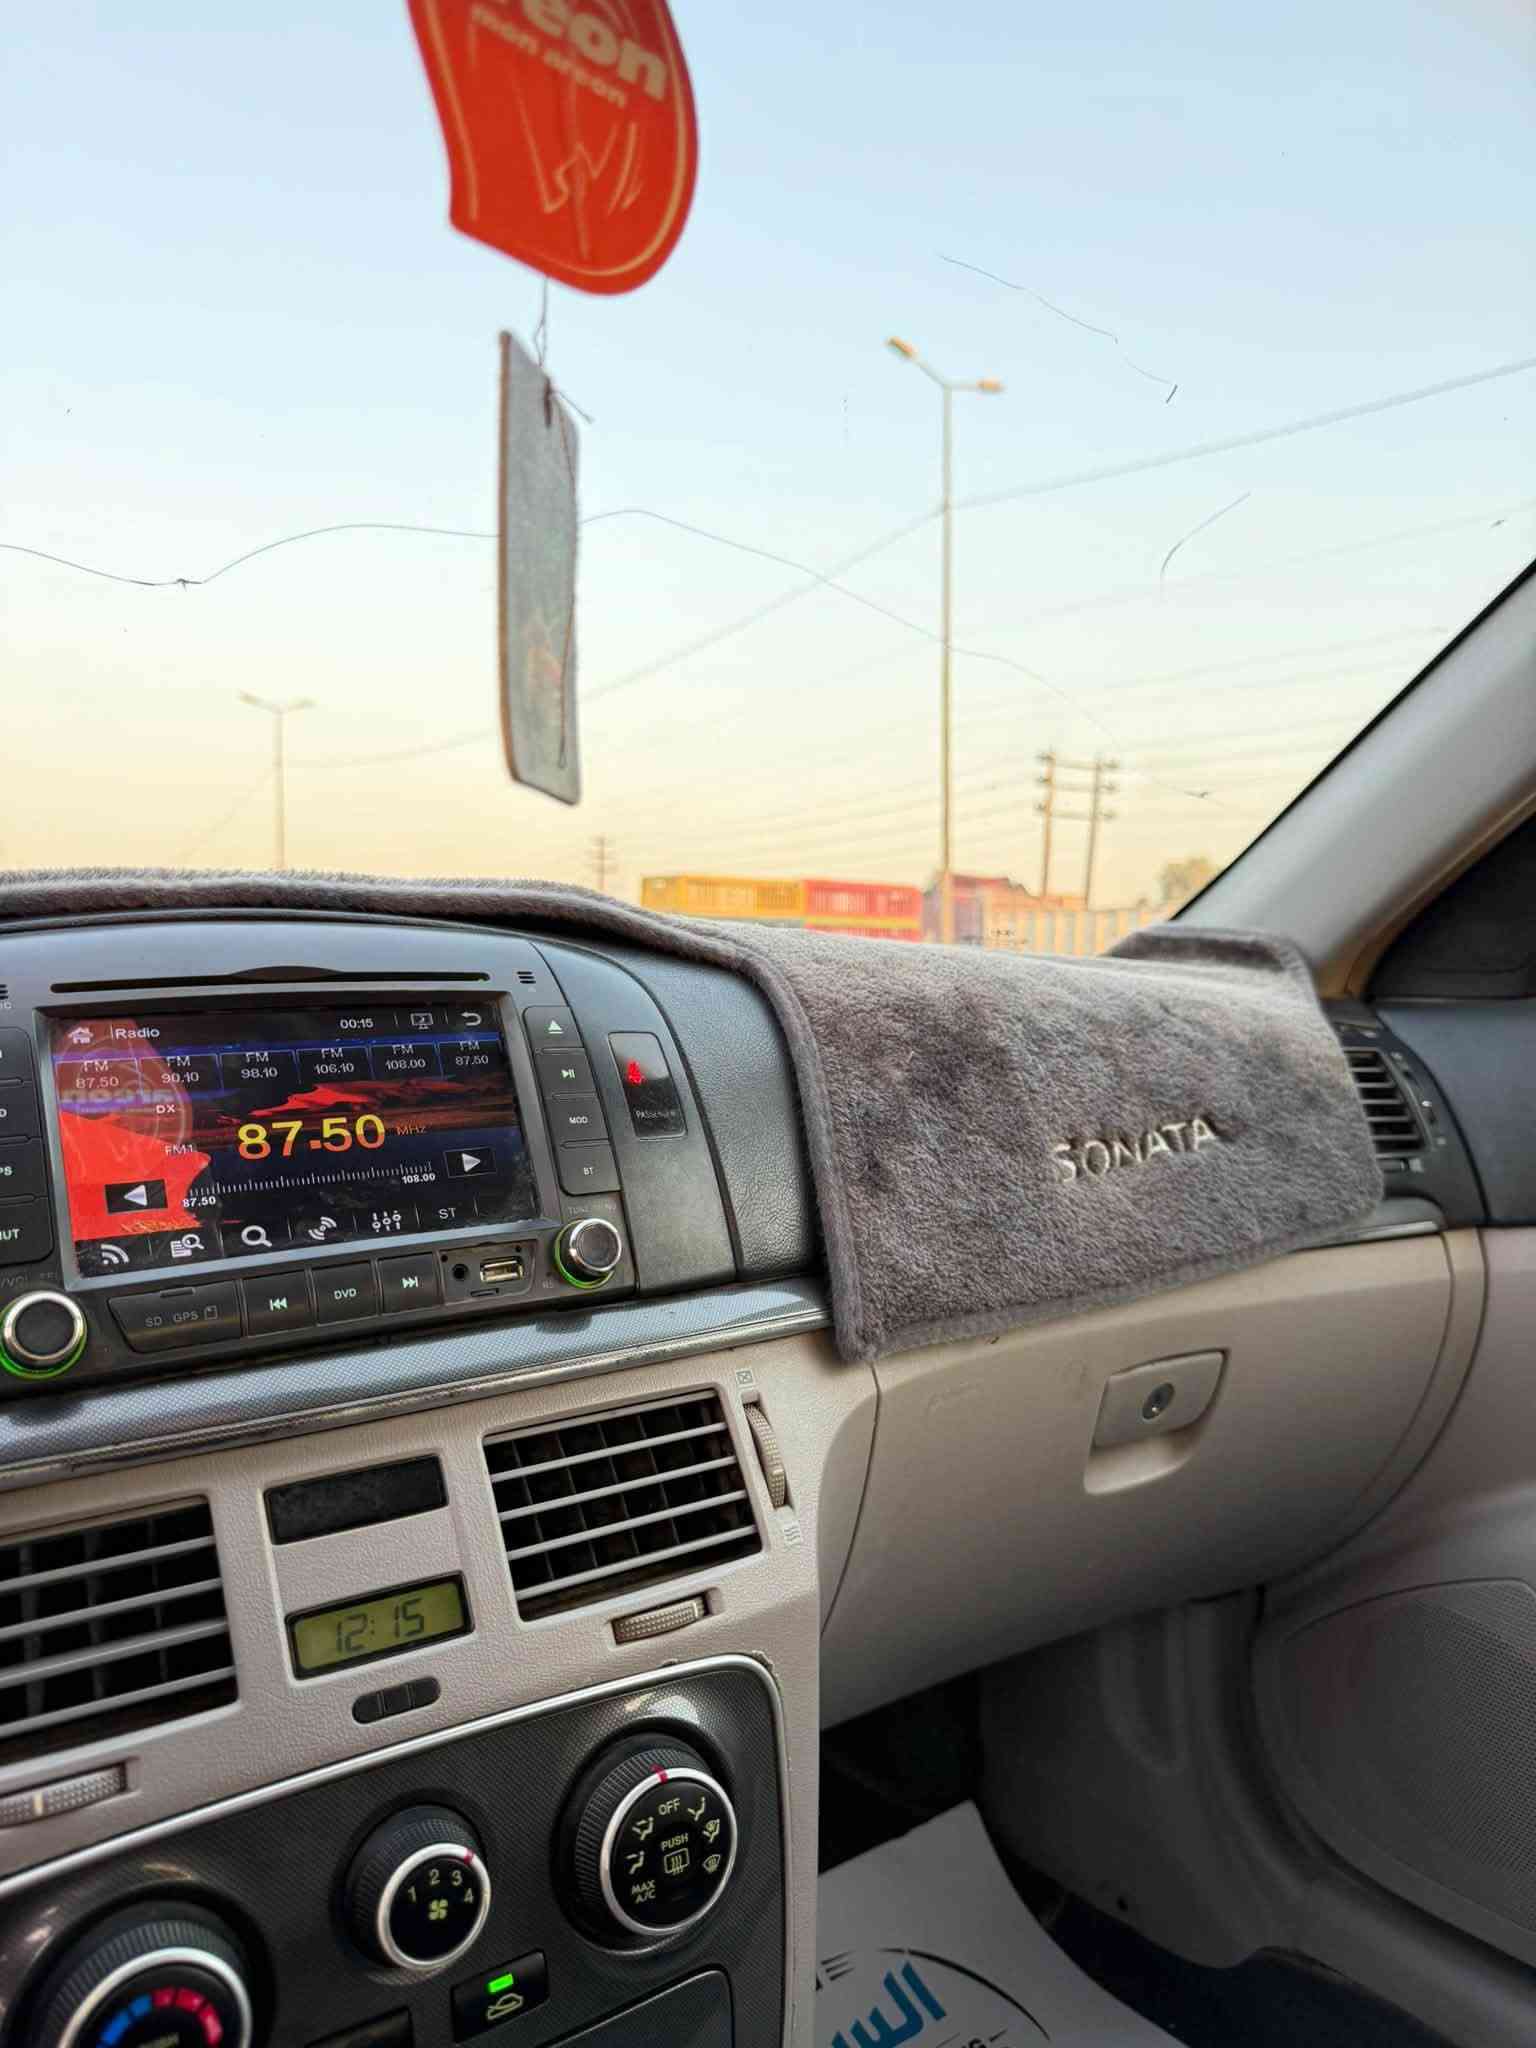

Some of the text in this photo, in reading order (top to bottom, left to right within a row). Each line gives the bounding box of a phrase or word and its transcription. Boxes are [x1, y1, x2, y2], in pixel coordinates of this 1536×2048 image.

[500, 0, 668, 102] eon
[339, 1018, 374, 1030] 00:15
[115, 1027, 160, 1039] Radio
[392, 1044, 414, 1055] FM
[459, 1040, 480, 1051] FM
[245, 1052, 269, 1063] FM
[321, 1048, 343, 1060] FM
[84, 1060, 109, 1072] FM
[167, 1056, 191, 1068] FM
[385, 1058, 426, 1070] 108.00
[455, 1055, 489, 1066] 87.50
[240, 1067, 278, 1079] 98.10
[314, 1062, 355, 1074] 106.10
[76, 1076, 119, 1089] 87.50
[161, 1071, 199, 1084] 90.10
[156, 1104, 176, 1114] DX
[568, 1115, 588, 1125] MOD
[237, 1114, 385, 1160] 87.50
[1053, 1117, 1218, 1183] SONATA
[583, 1167, 594, 1176] BT
[401, 1173, 436, 1184] 108.00
[182, 1196, 216, 1208] 87.50
[438, 1207, 456, 1219] ST
[334, 1288, 357, 1300] DVD
[145, 1311, 199, 1327] SD GPS
[336, 1599, 424, 1653] 12:15
[658, 1798, 681, 1815] OFF
[661, 1833, 689, 1850] PUSH
[428, 1869, 440, 1885] 2
[452, 1870, 463, 1886] 3
[631, 1880, 655, 1895] MAX
[408, 1886, 417, 1902] 1
[464, 1888, 474, 1903] 4
[636, 1889, 655, 1904] A/C
